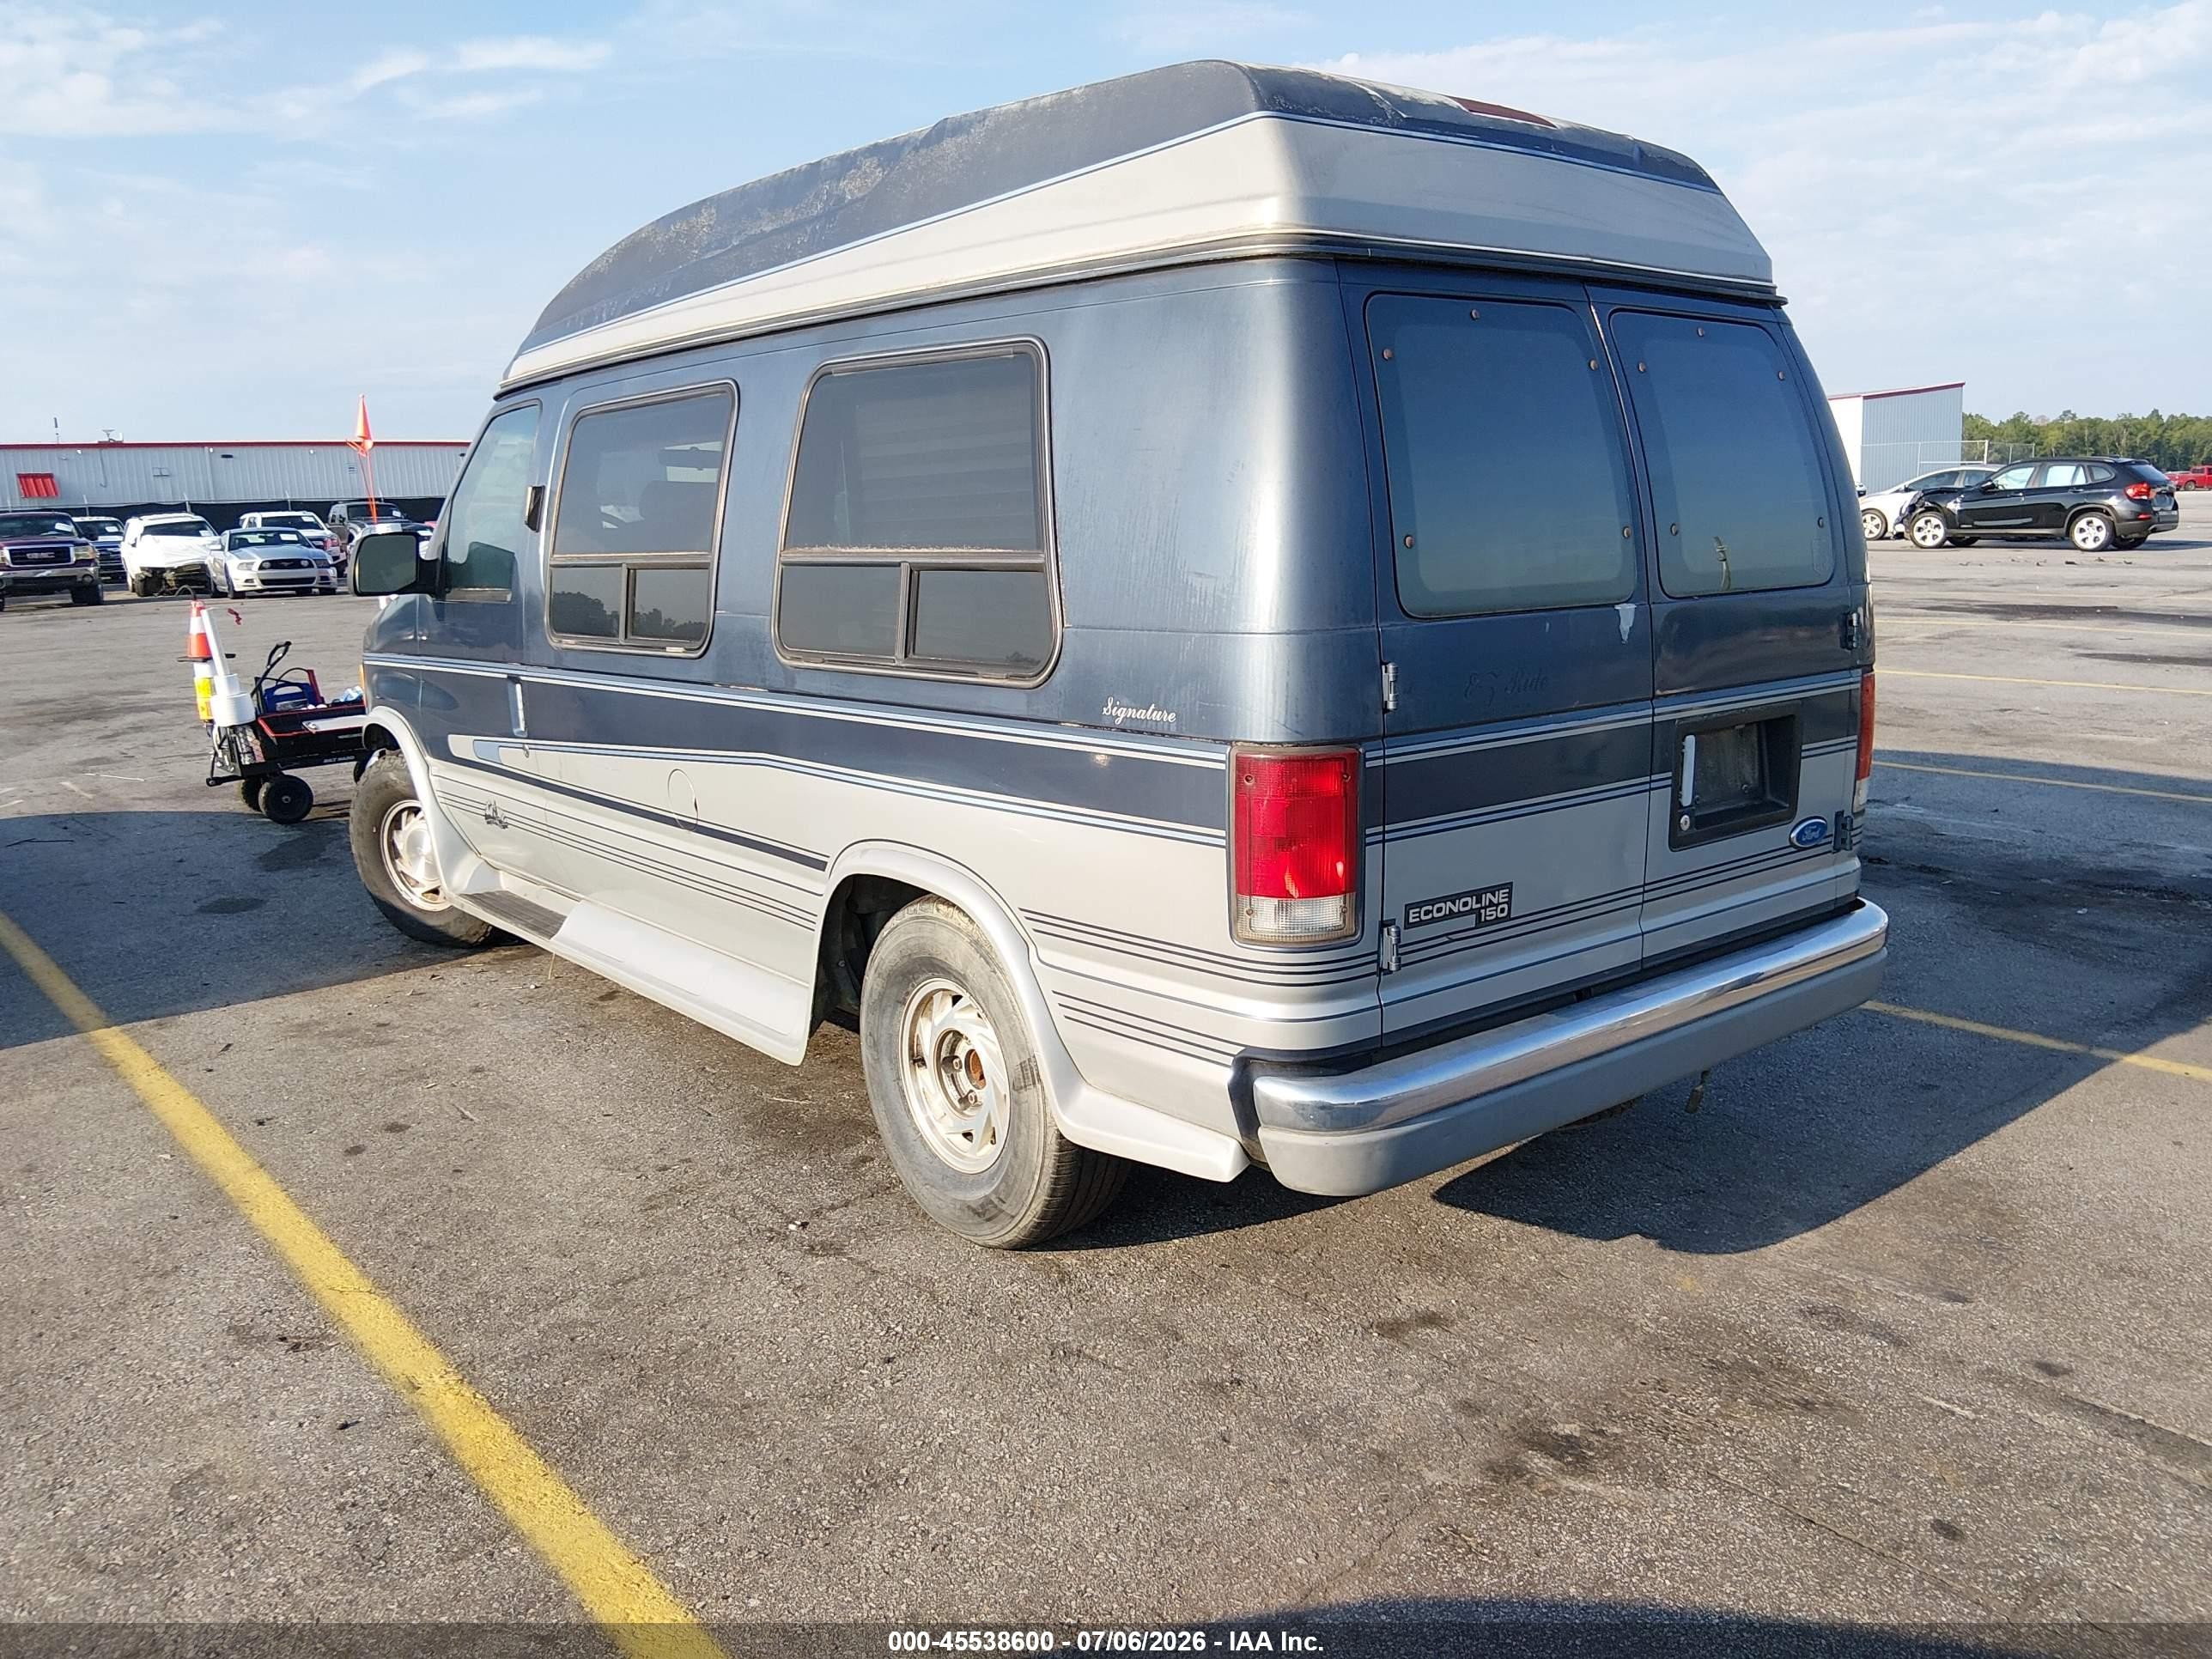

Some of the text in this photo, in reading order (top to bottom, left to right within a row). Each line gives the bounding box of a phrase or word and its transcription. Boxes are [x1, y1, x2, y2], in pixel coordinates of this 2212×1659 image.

[1103, 696, 1176, 725] Signature
[1408, 889, 1510, 923] ECONOLINE
[1480, 903, 1509, 922] 150
